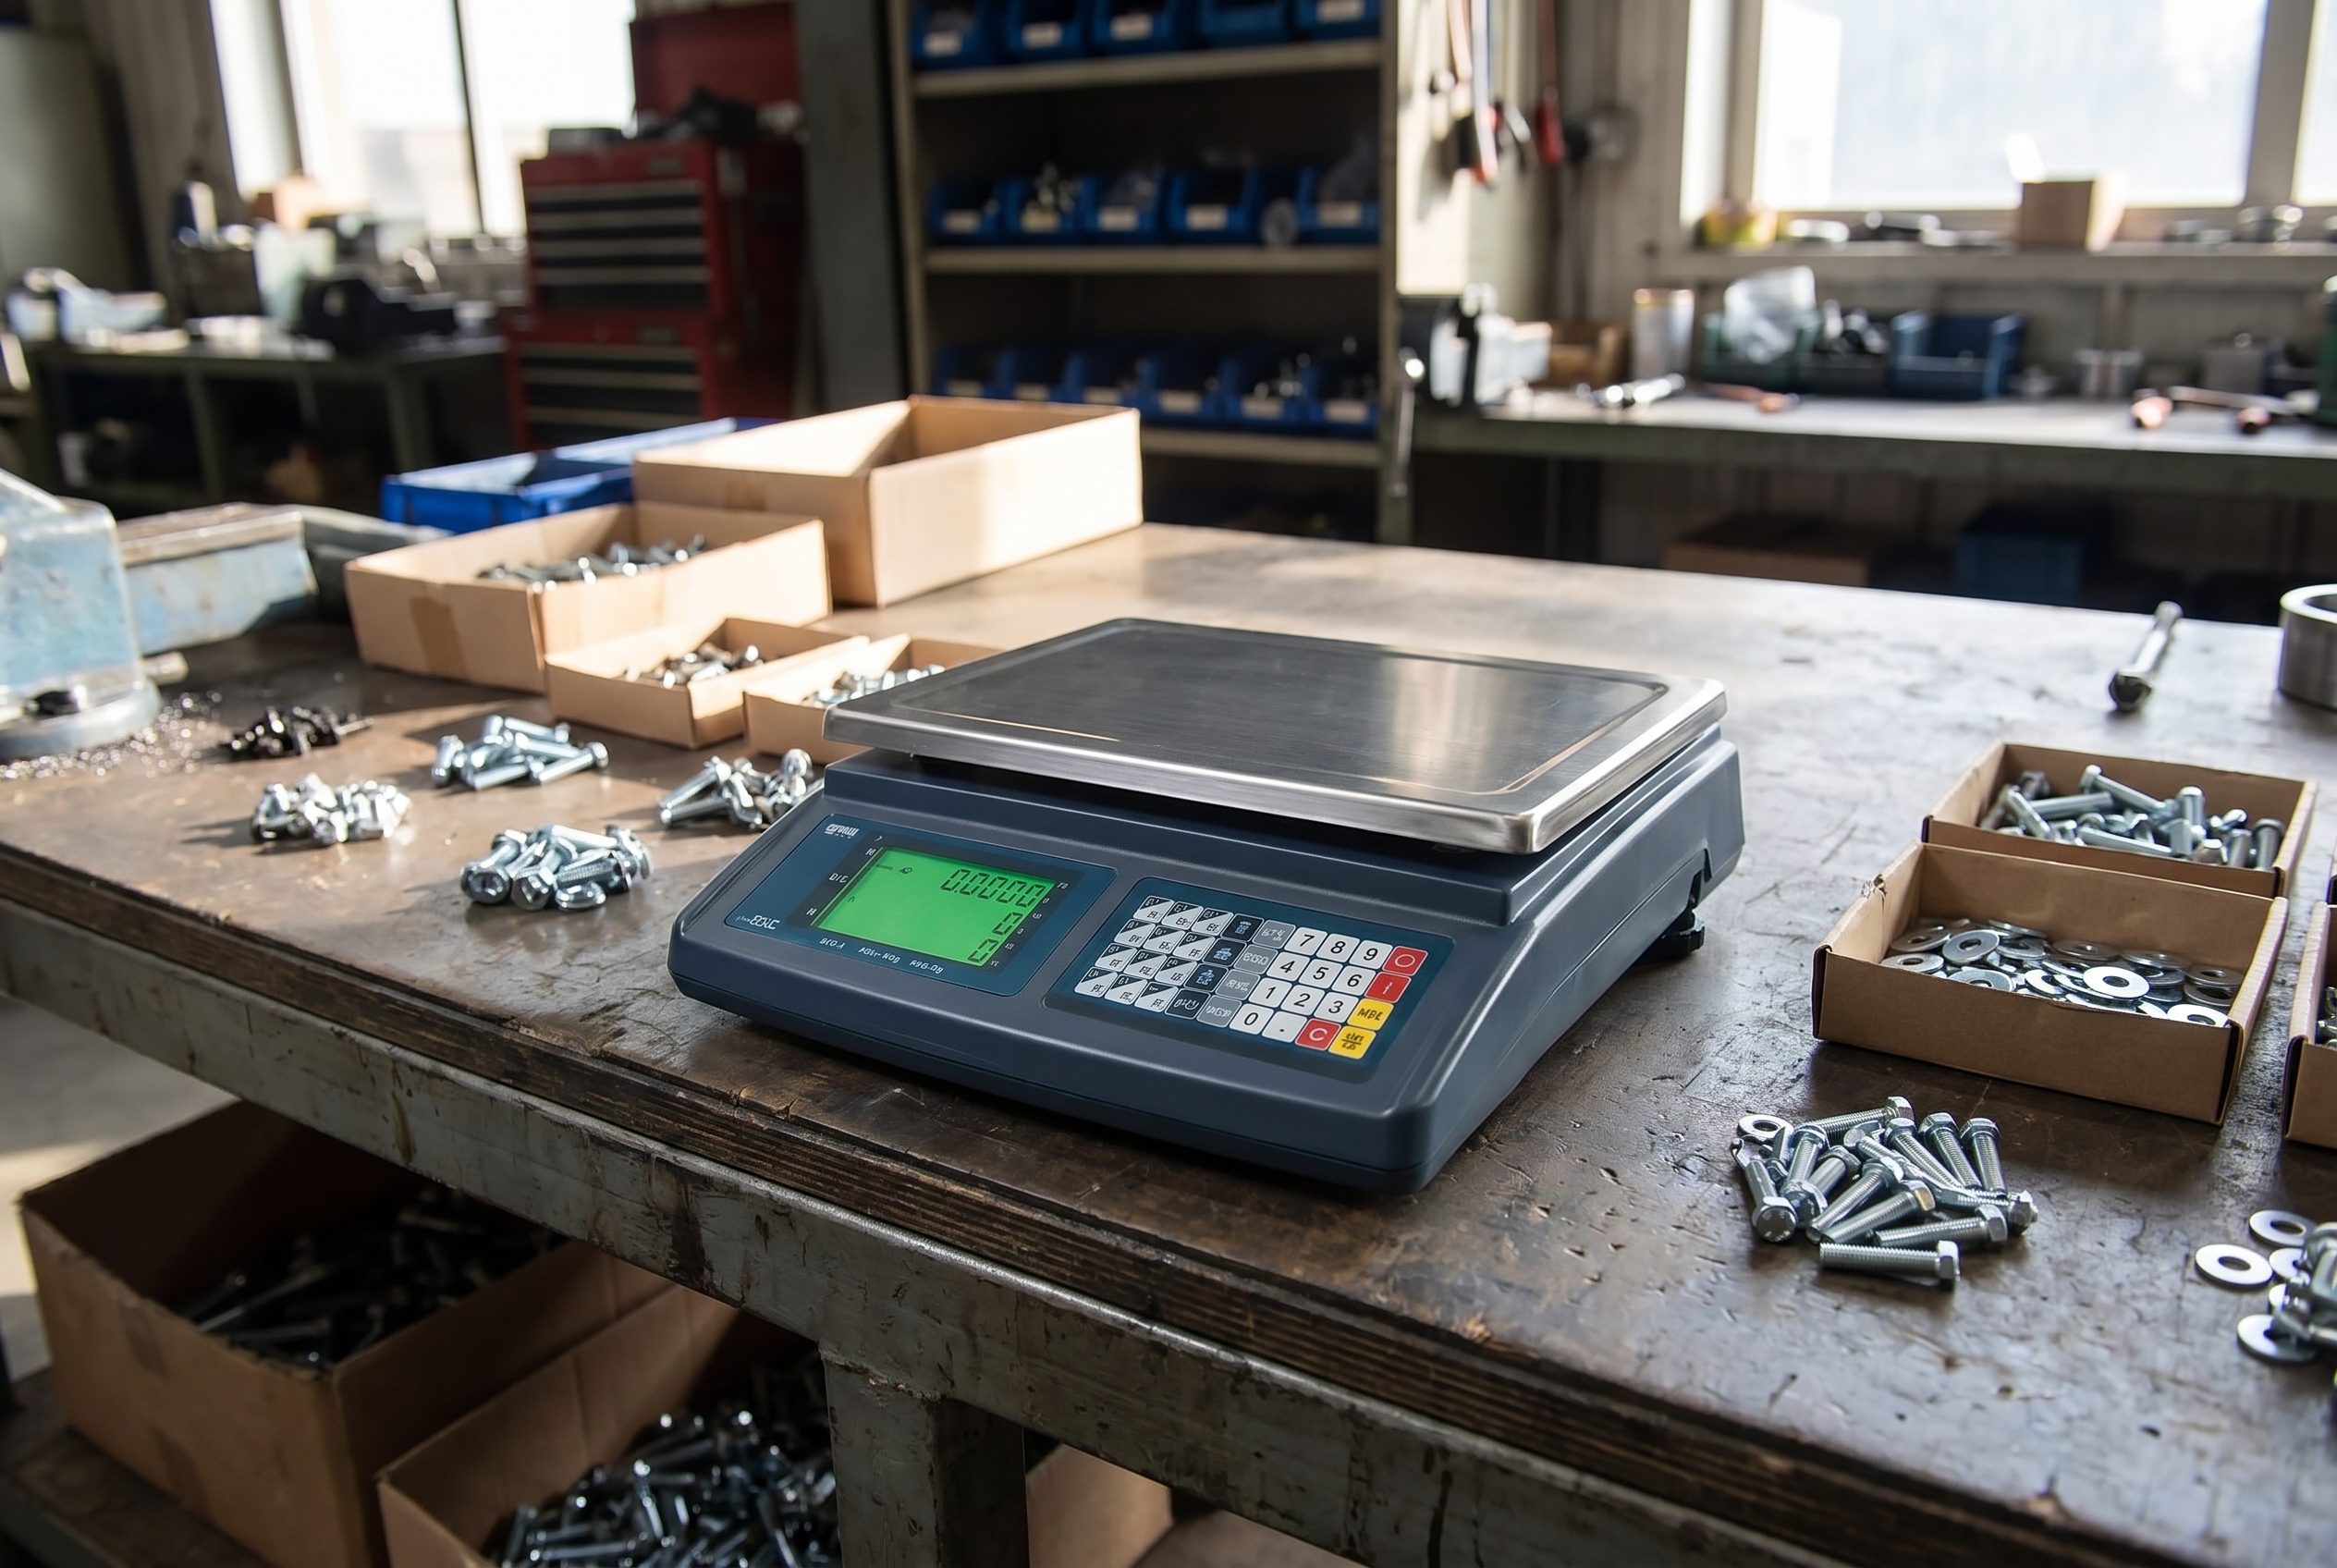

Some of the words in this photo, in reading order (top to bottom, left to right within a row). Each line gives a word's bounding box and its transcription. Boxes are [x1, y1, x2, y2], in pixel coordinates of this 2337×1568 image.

[940, 868, 1046, 908] 0.0000
[1299, 934, 1315, 947] 7
[1330, 940, 1346, 954] 8
[1363, 948, 1378, 962] 9
[1279, 961, 1296, 974] 4
[1313, 966, 1329, 980] 5
[1347, 974, 1363, 987] 6
[1265, 986, 1277, 999] 1
[1293, 993, 1311, 1008] 2
[1328, 1000, 1344, 1014] 3
[1243, 1012, 1259, 1026] 0
[1308, 1027, 1328, 1041] C
